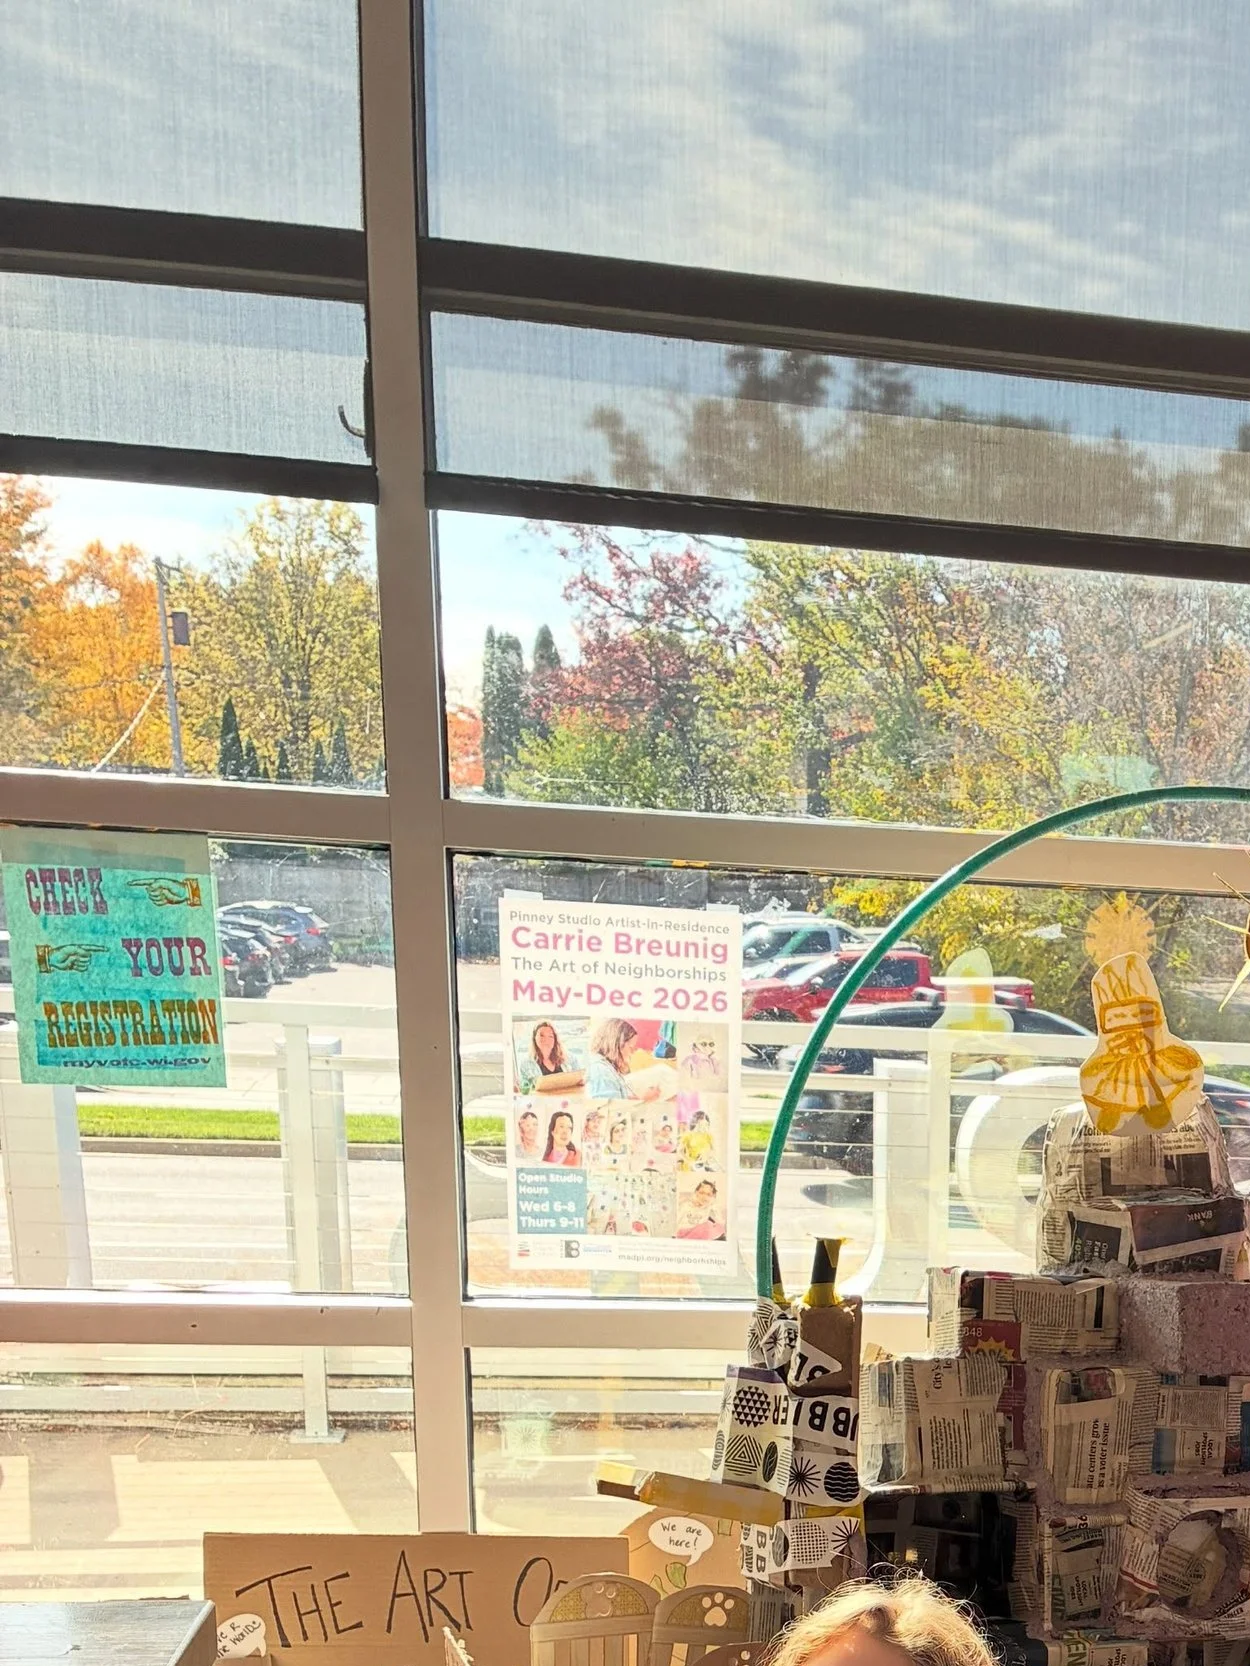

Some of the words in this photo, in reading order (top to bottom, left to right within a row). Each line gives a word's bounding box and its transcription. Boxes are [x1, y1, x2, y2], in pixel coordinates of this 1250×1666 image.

[25, 867, 109, 916] CHECK
[510, 910, 553, 925] Pinney
[558, 914, 601, 926] Studio
[605, 917, 730, 935] Artist-in-Residence
[121, 937, 212, 978] YOUR
[511, 926, 603, 953] Carrie
[614, 931, 728, 964] Breunig
[511, 957, 543, 971] The
[549, 959, 576, 974] Art
[581, 961, 599, 974] of
[604, 962, 727, 982] Neighborships
[512, 979, 642, 1008] May-Dec
[653, 987, 728, 1012] 2026
[43, 998, 219, 1049] REGISTRATION
[518, 1172, 546, 1185] Open
[549, 1173, 583, 1184] Studio
[519, 1185, 549, 1195] Hours
[519, 1201, 549, 1212] Wed
[553, 1202, 576, 1213] 6-8
[519, 1217, 557, 1228] Thurs
[559, 1217, 584, 1228] 9-11
[661, 1521, 678, 1534] We
[685, 1526, 703, 1537] are
[668, 1536, 699, 1550] here!
[235, 1565, 363, 1648] THE
[386, 1550, 474, 1643] ART
[513, 1556, 568, 1627] O
